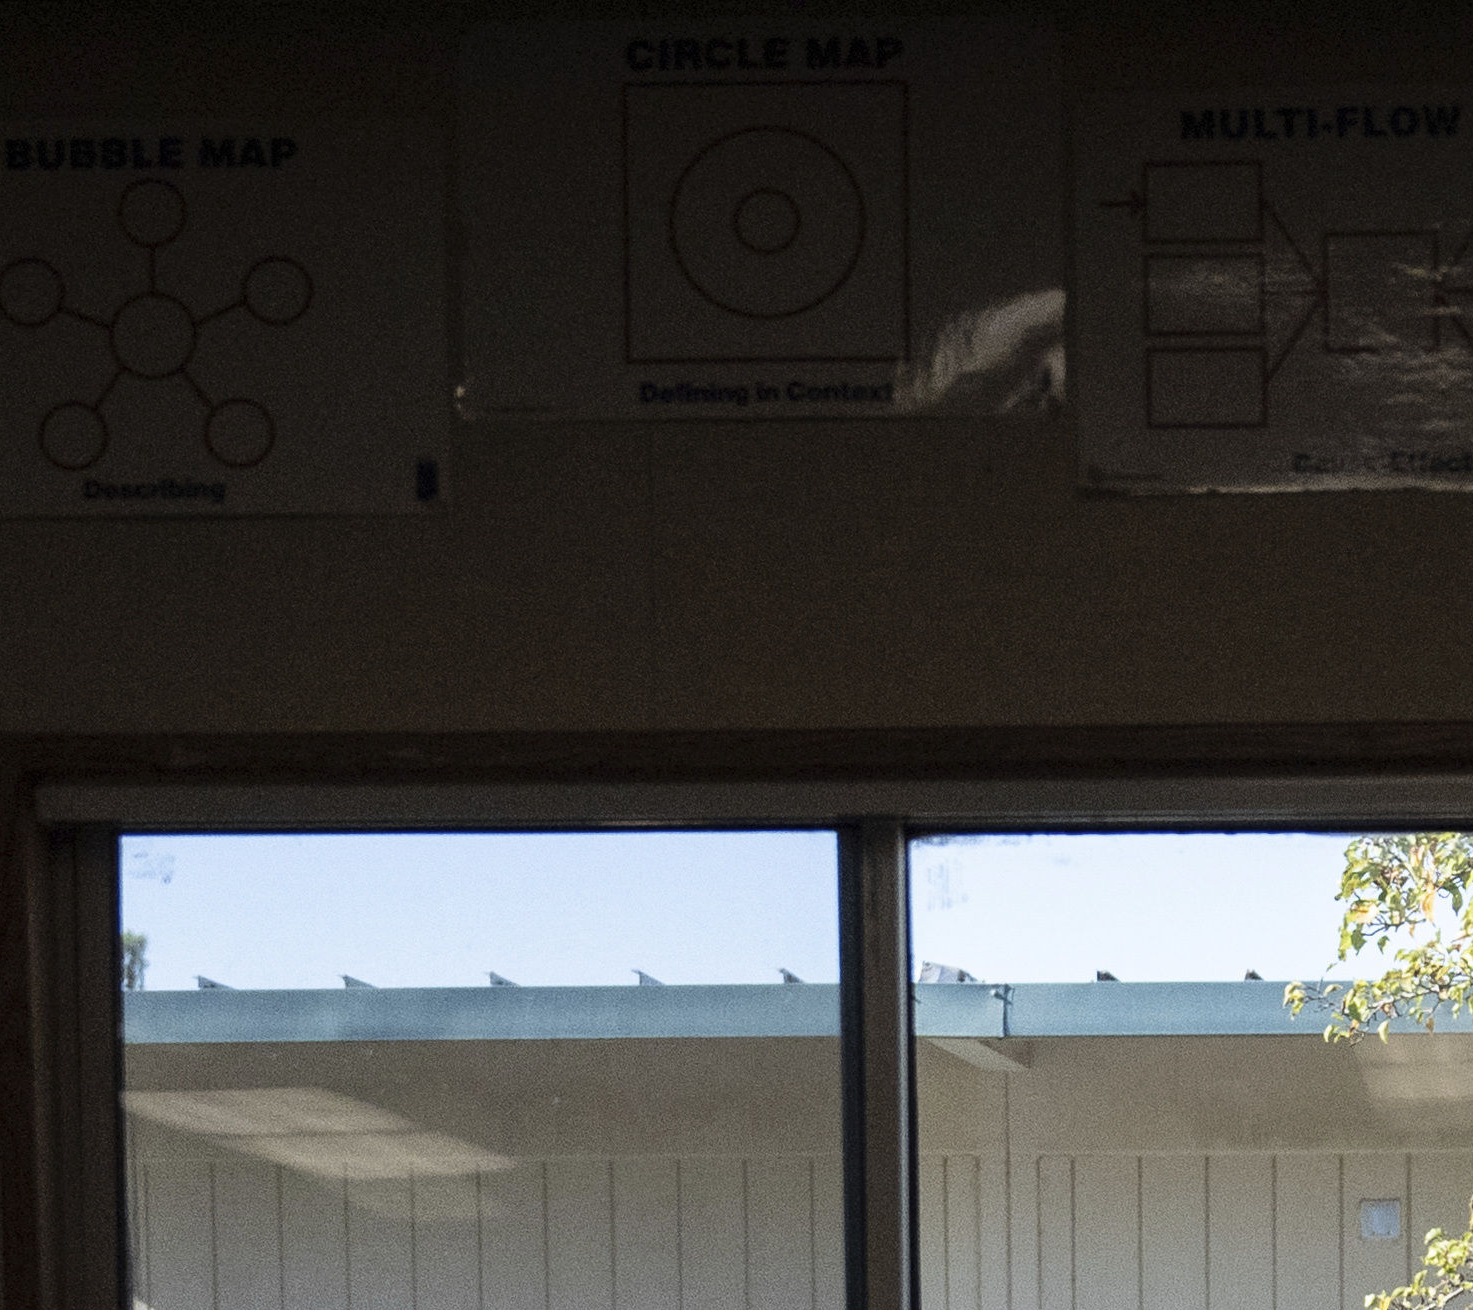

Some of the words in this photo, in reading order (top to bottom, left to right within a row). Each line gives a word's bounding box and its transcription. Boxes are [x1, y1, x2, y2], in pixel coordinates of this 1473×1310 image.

[625, 37, 790, 71] CIRCLE
[806, 35, 903, 69] MAP
[1181, 105, 1461, 140] MULTI-FLOW
[5, 137, 182, 170] BUBBLE
[199, 137, 298, 168] MAP
[640, 381, 750, 406] Defining
[755, 383, 780, 401] in
[785, 381, 893, 402] Context
[83, 479, 226, 503] Describing
